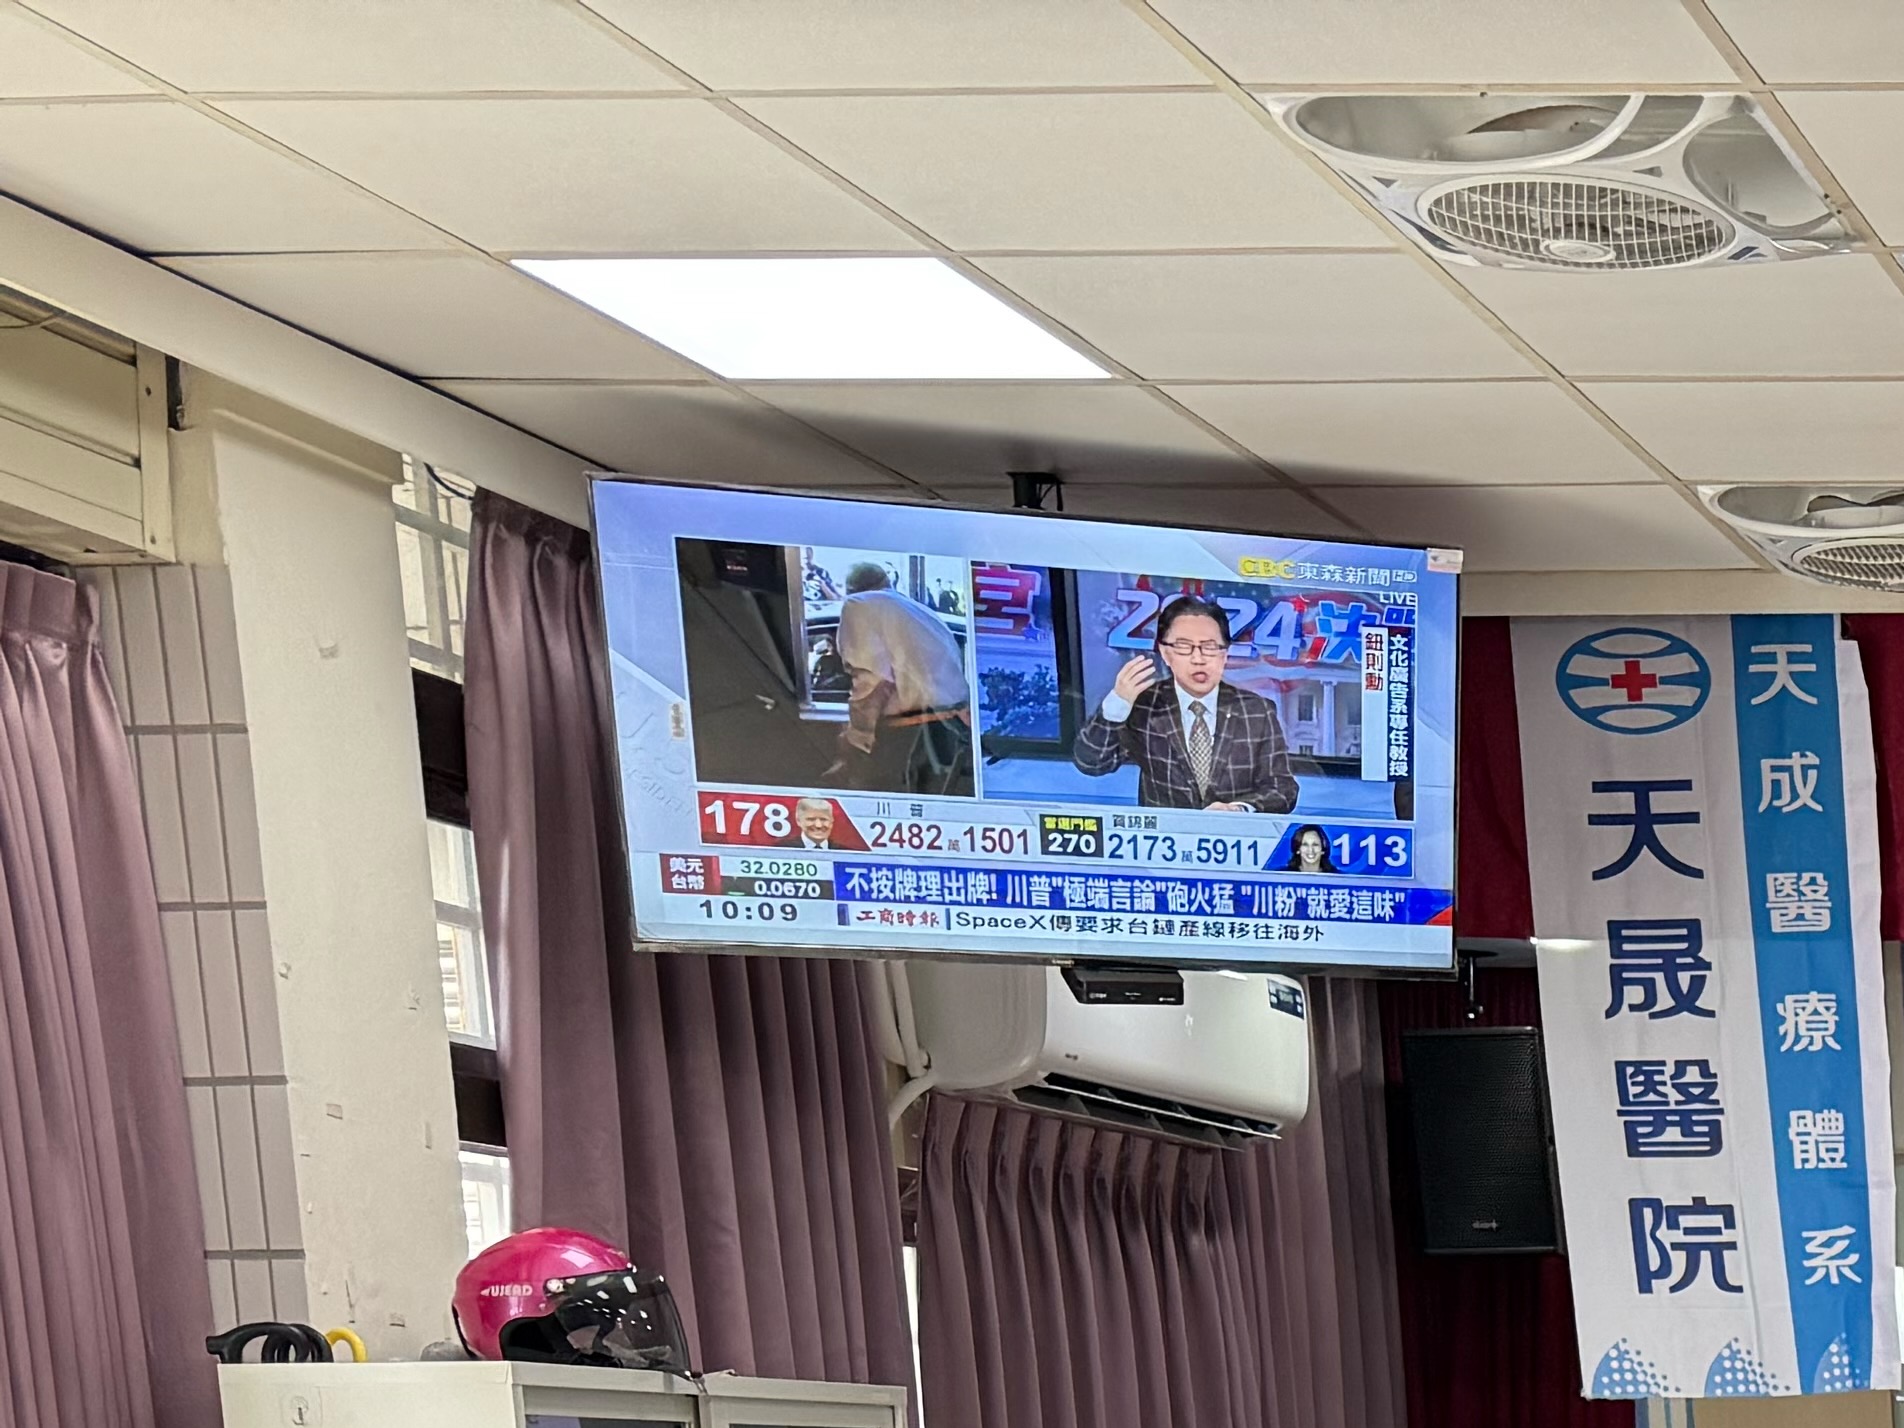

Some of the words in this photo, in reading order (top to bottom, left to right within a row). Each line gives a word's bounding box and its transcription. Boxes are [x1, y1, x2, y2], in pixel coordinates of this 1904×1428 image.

[1297, 562, 1391, 587] 東森新聞
[1379, 591, 1418, 606] LIVE
[703, 799, 793, 839] 178
[1047, 833, 1098, 855] 270
[1333, 834, 1409, 867] 113
[669, 857, 704, 874] 美元
[740, 860, 819, 878] 32.0280
[671, 874, 706, 891] 台幣
[753, 880, 821, 898] 0.0670
[844, 866, 998, 905] 不按牌理出牌!
[699, 900, 799, 922] 10:09
[856, 908, 940, 928] 工商時報
[1747, 641, 1863, 1286] 天成醫療體系
[1586, 779, 1744, 1297] 天晟醫院
